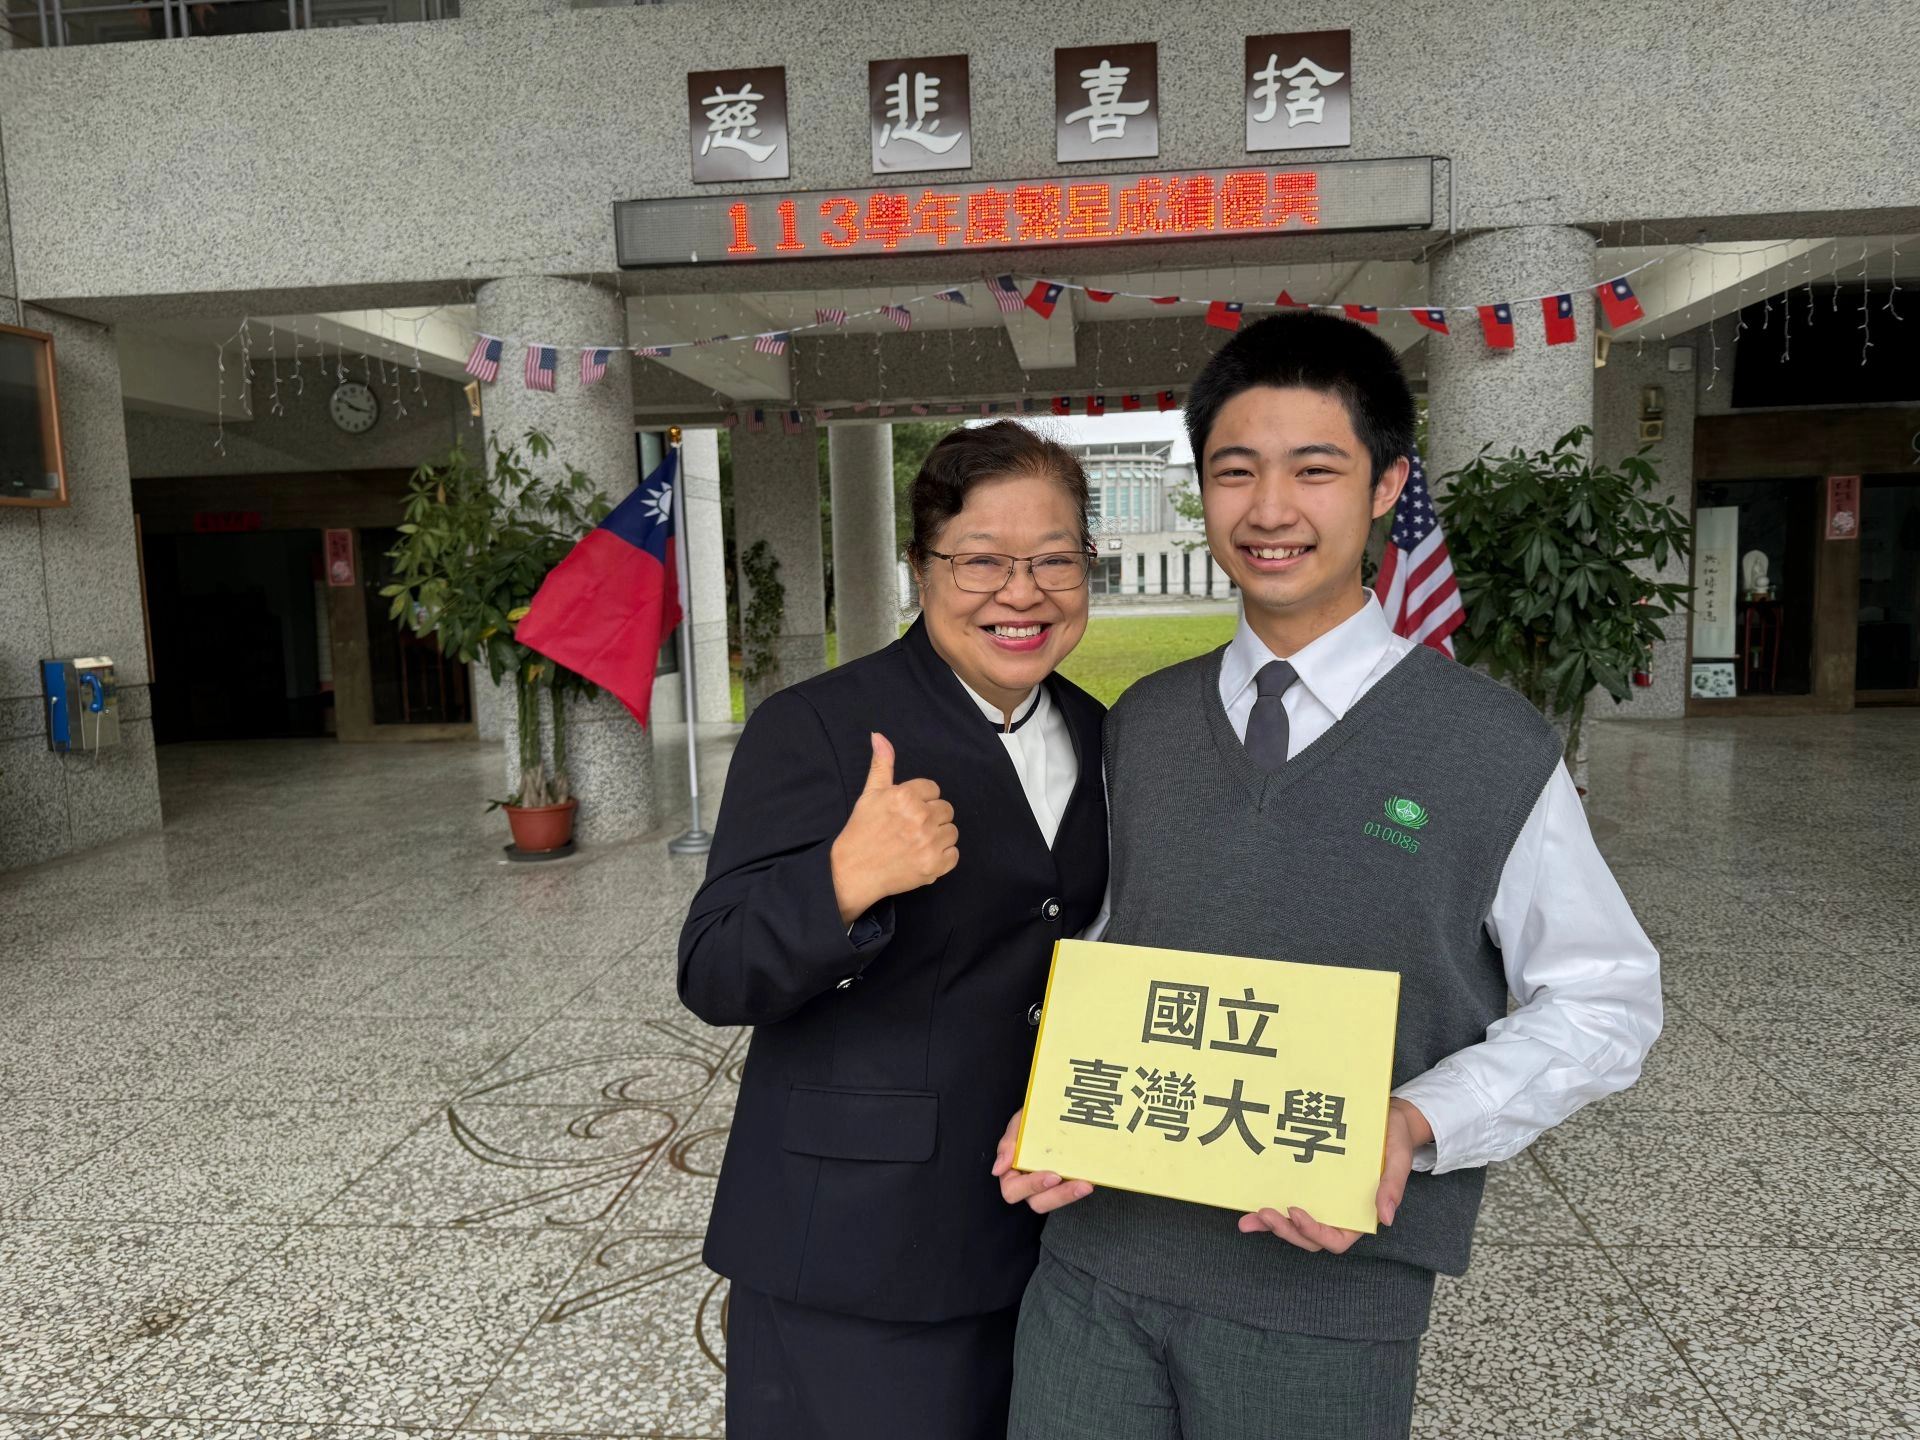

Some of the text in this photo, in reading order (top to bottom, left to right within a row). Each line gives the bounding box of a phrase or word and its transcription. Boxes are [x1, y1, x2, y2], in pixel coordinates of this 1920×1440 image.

[727, 172, 1319, 254] 113學年度繁星成績優異
[1364, 820, 1421, 854] 010085
[1141, 979, 1281, 1058] 國立
[1059, 1058, 1348, 1164] 臺灣大學
